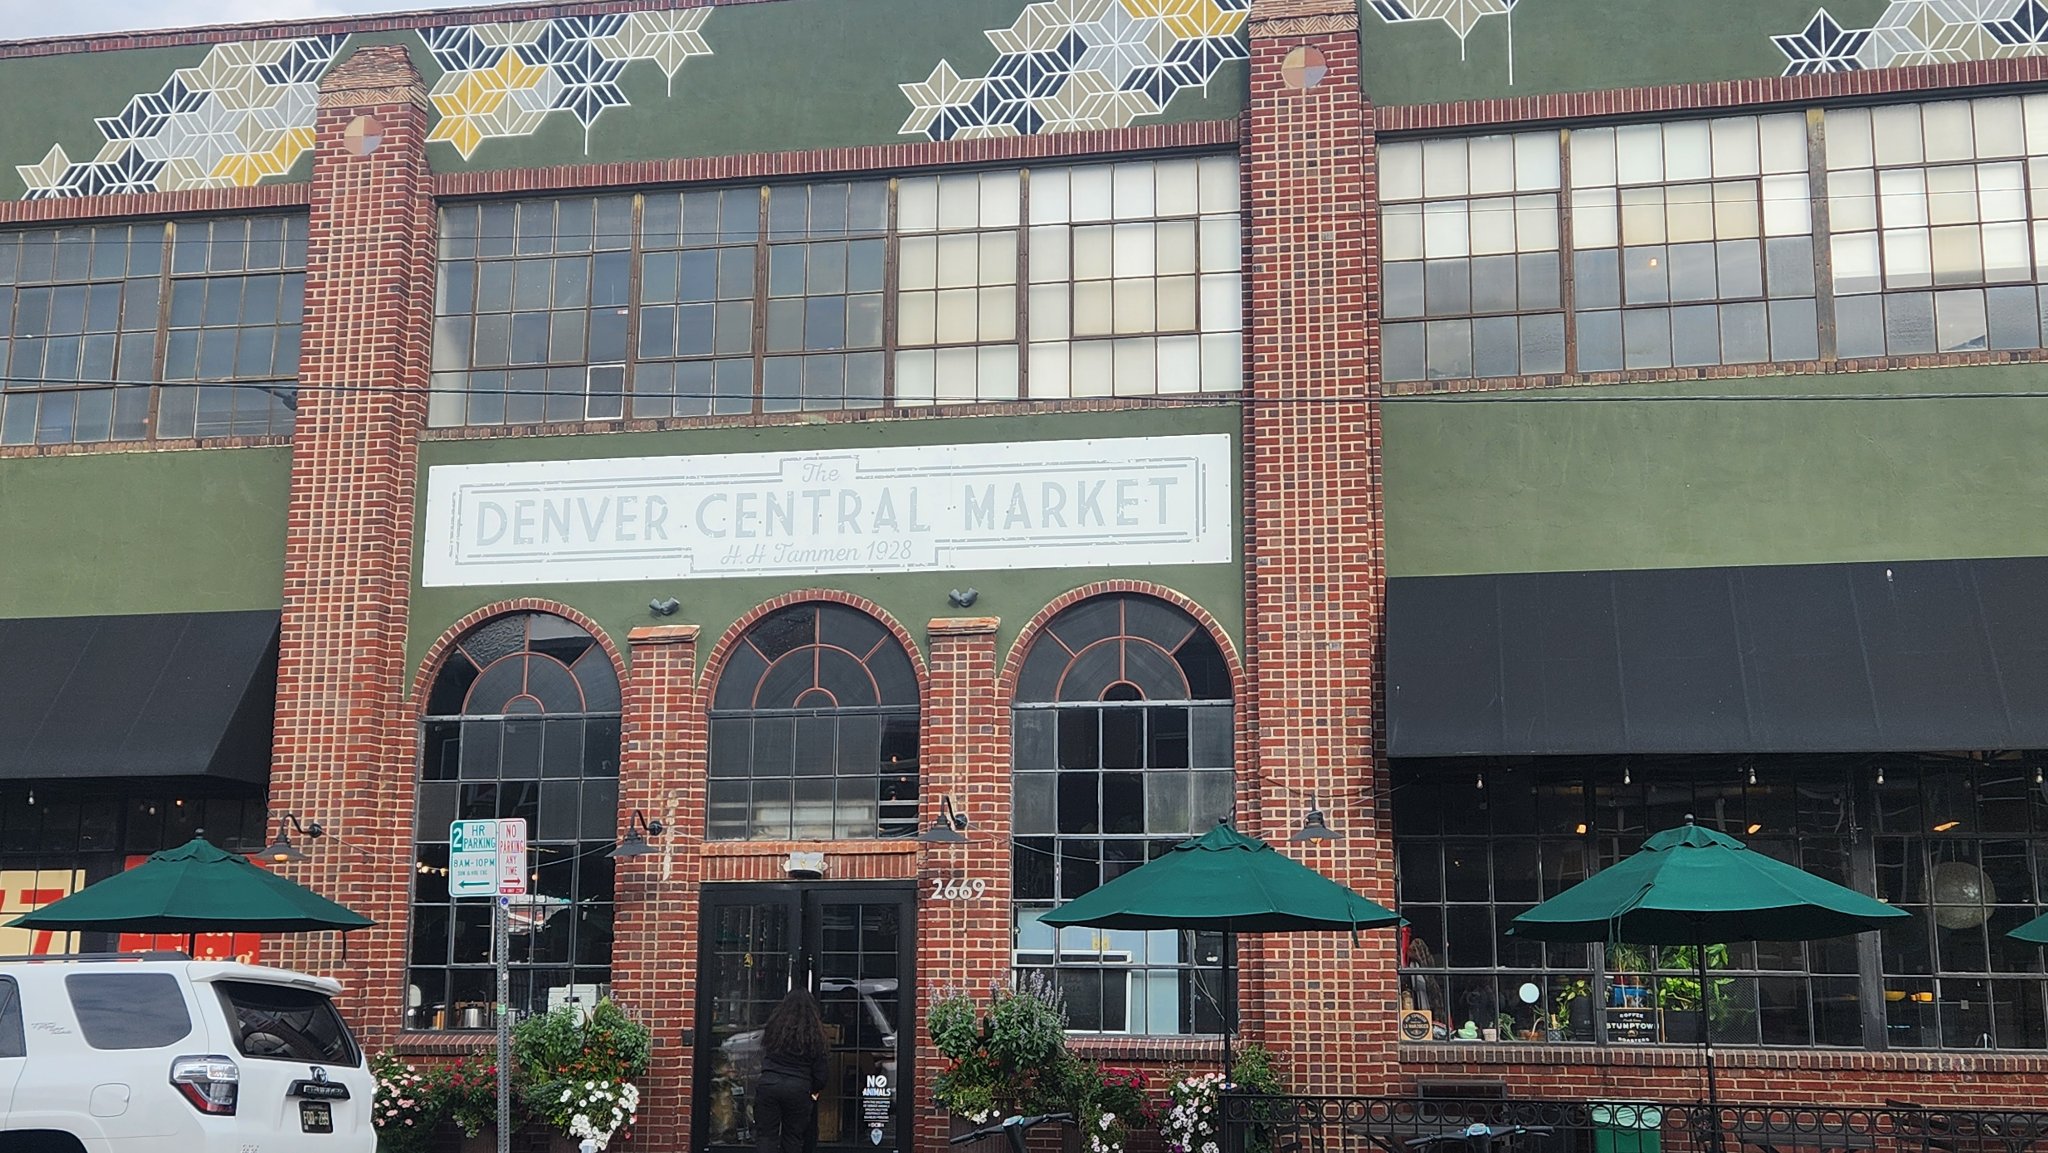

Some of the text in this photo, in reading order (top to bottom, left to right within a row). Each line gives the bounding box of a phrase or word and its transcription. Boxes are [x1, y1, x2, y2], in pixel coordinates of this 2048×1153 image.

[802, 463, 840, 482] The
[477, 477, 1178, 546] DENVER CENTRAL MARKET
[773, 542, 860, 564] Tammen
[866, 540, 912, 562] 1928
[471, 825, 486, 836] HR
[506, 824, 517, 838] NO
[453, 827, 463, 848] 2
[463, 837, 496, 849] PARKING
[500, 840, 524, 853] PARKING
[506, 856, 517, 864] ANY
[505, 866, 518, 875] TIME
[931, 879, 986, 900] 2669
[867, 1075, 887, 1088] NO
[862, 1088, 892, 1097] ANIMALS
